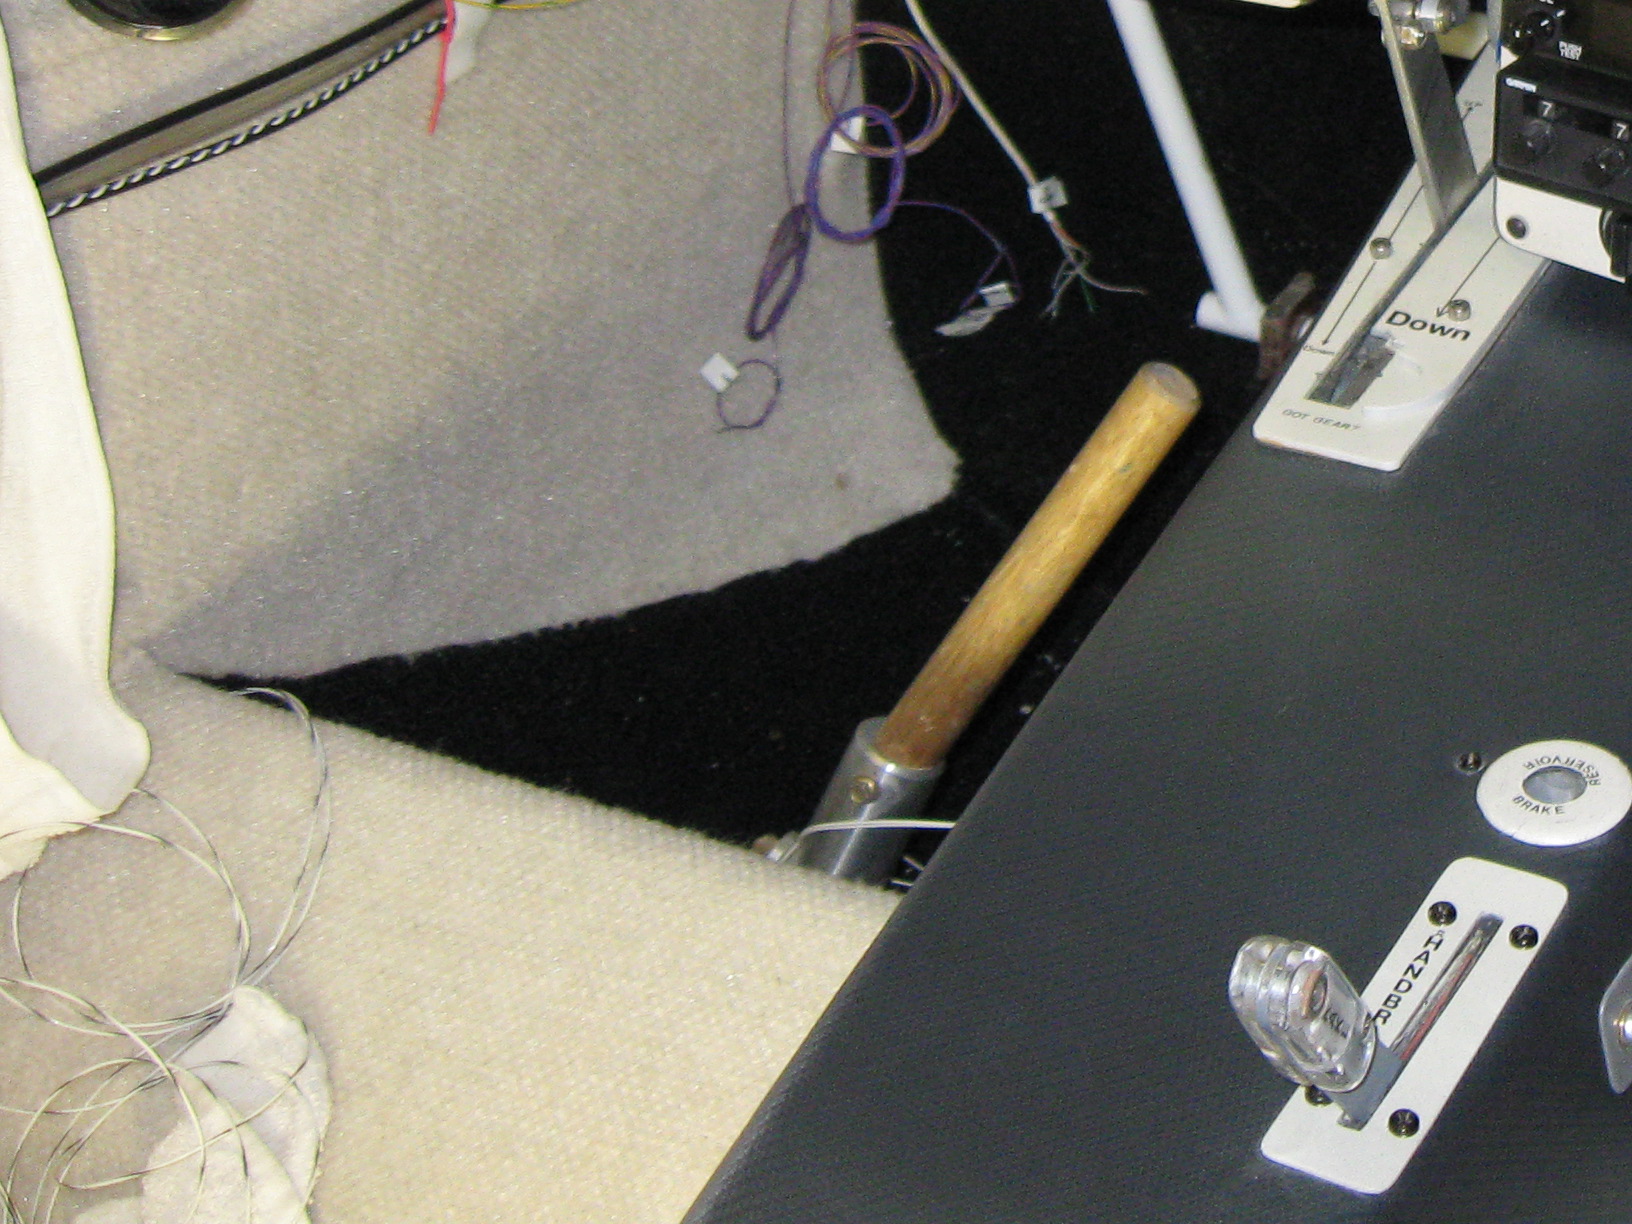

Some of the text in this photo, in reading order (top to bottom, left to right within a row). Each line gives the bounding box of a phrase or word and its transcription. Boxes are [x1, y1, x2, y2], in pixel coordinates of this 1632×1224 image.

[1541, 100, 1553, 117] 7
[1615, 122, 1628, 139] 7
[1386, 310, 1472, 342] Down
[1281, 408, 1362, 432] GOT GEAR?
[1523, 755, 1601, 786] RESERVOIR
[1512, 795, 1566, 816] BRAKE
[1372, 935, 1445, 1026] HANDBR
